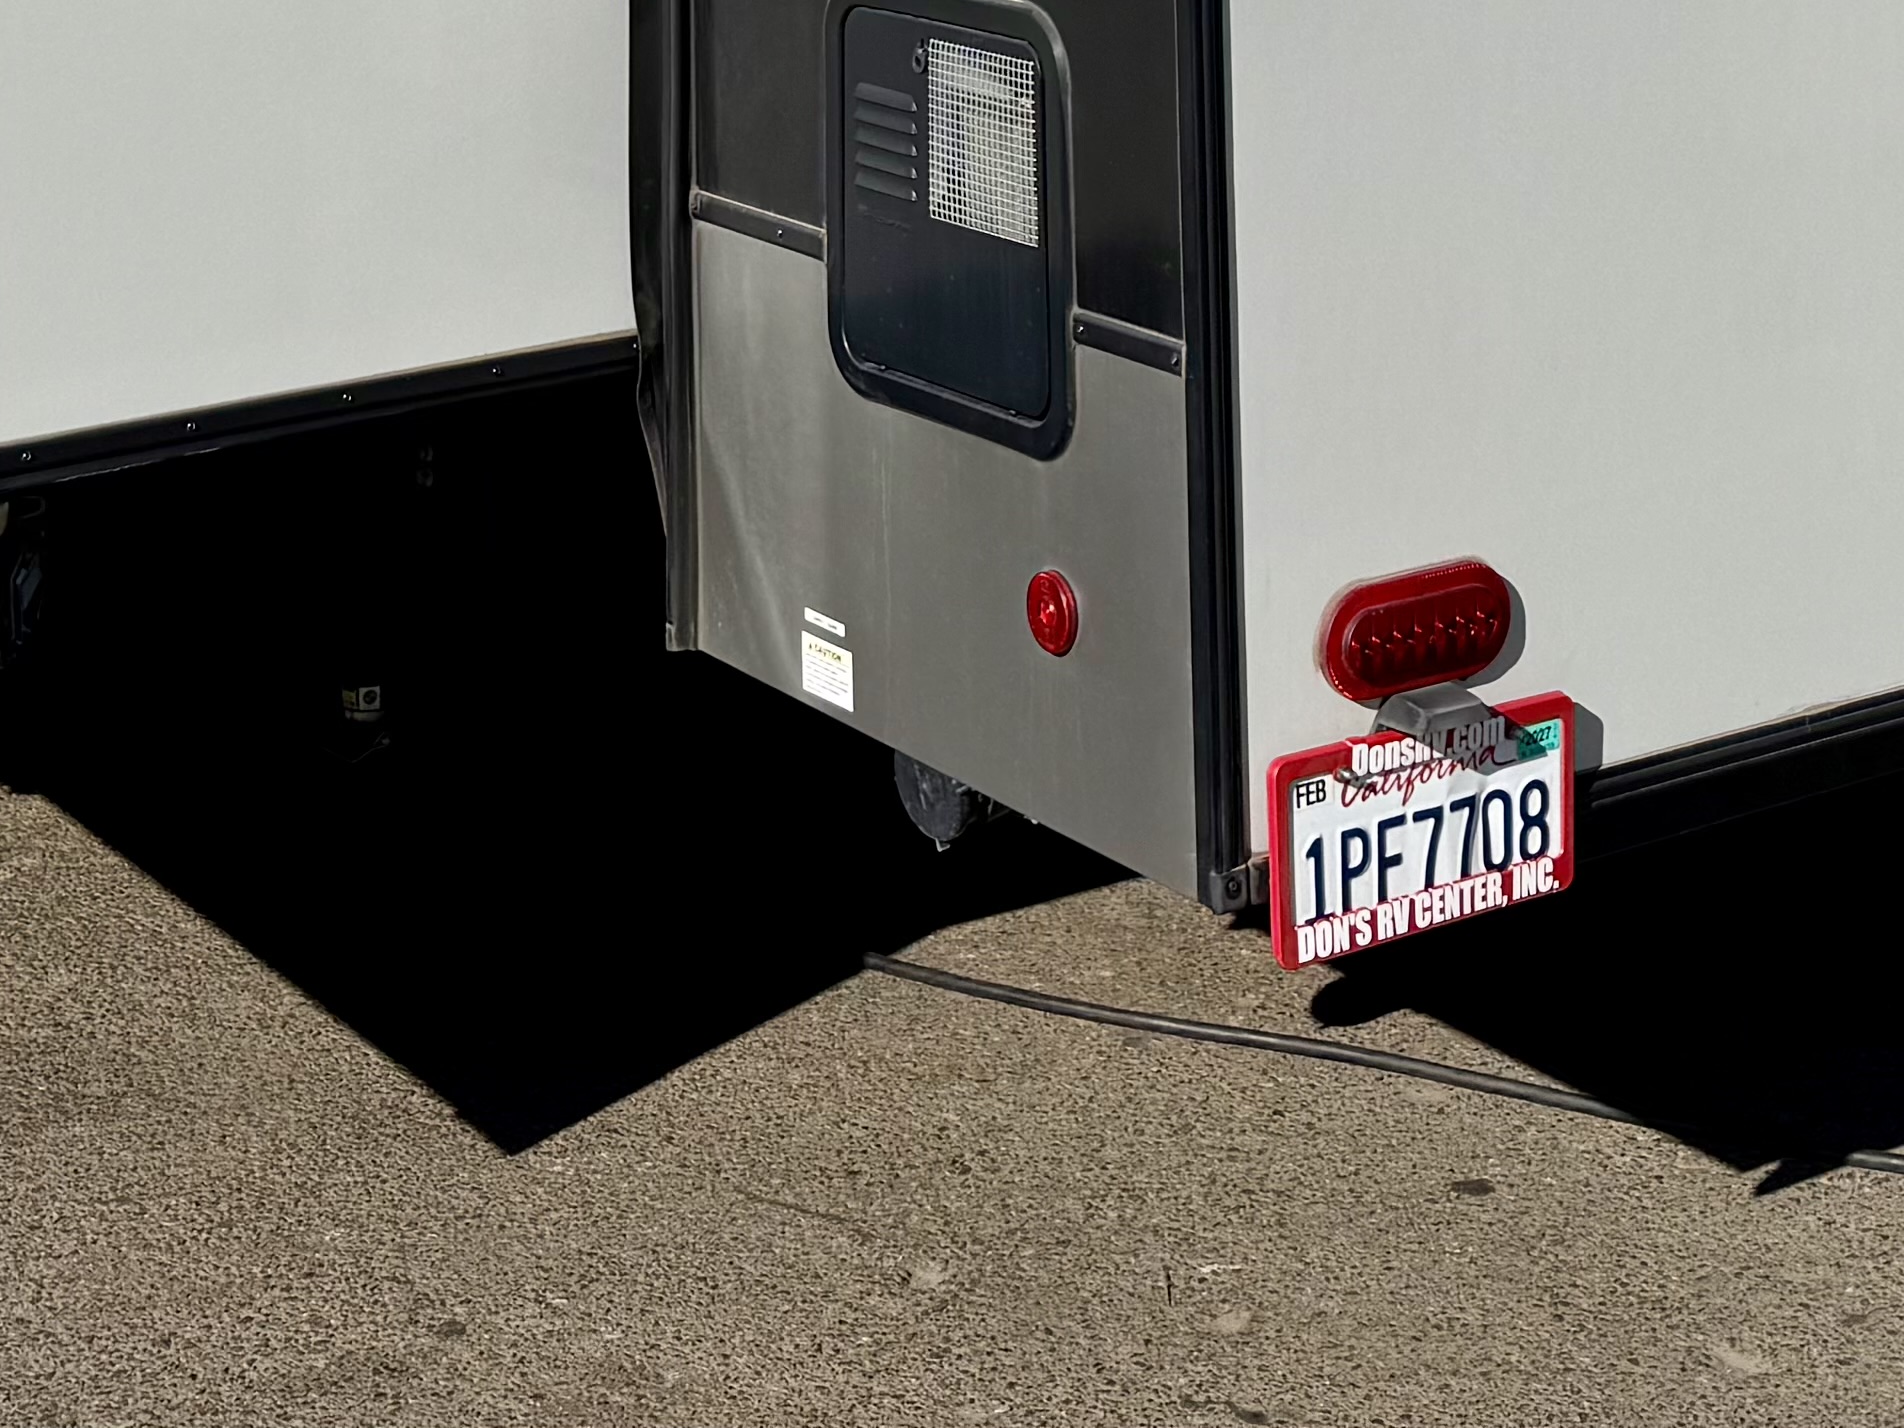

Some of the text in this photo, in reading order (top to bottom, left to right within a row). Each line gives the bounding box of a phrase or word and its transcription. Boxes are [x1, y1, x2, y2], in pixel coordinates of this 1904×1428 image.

[1296, 778, 1327, 809] FEB
[1341, 745, 1517, 808] California
[1305, 778, 1550, 924] 1PF7708
[1297, 856, 1560, 964] DON'S RV CENTER, INC.
